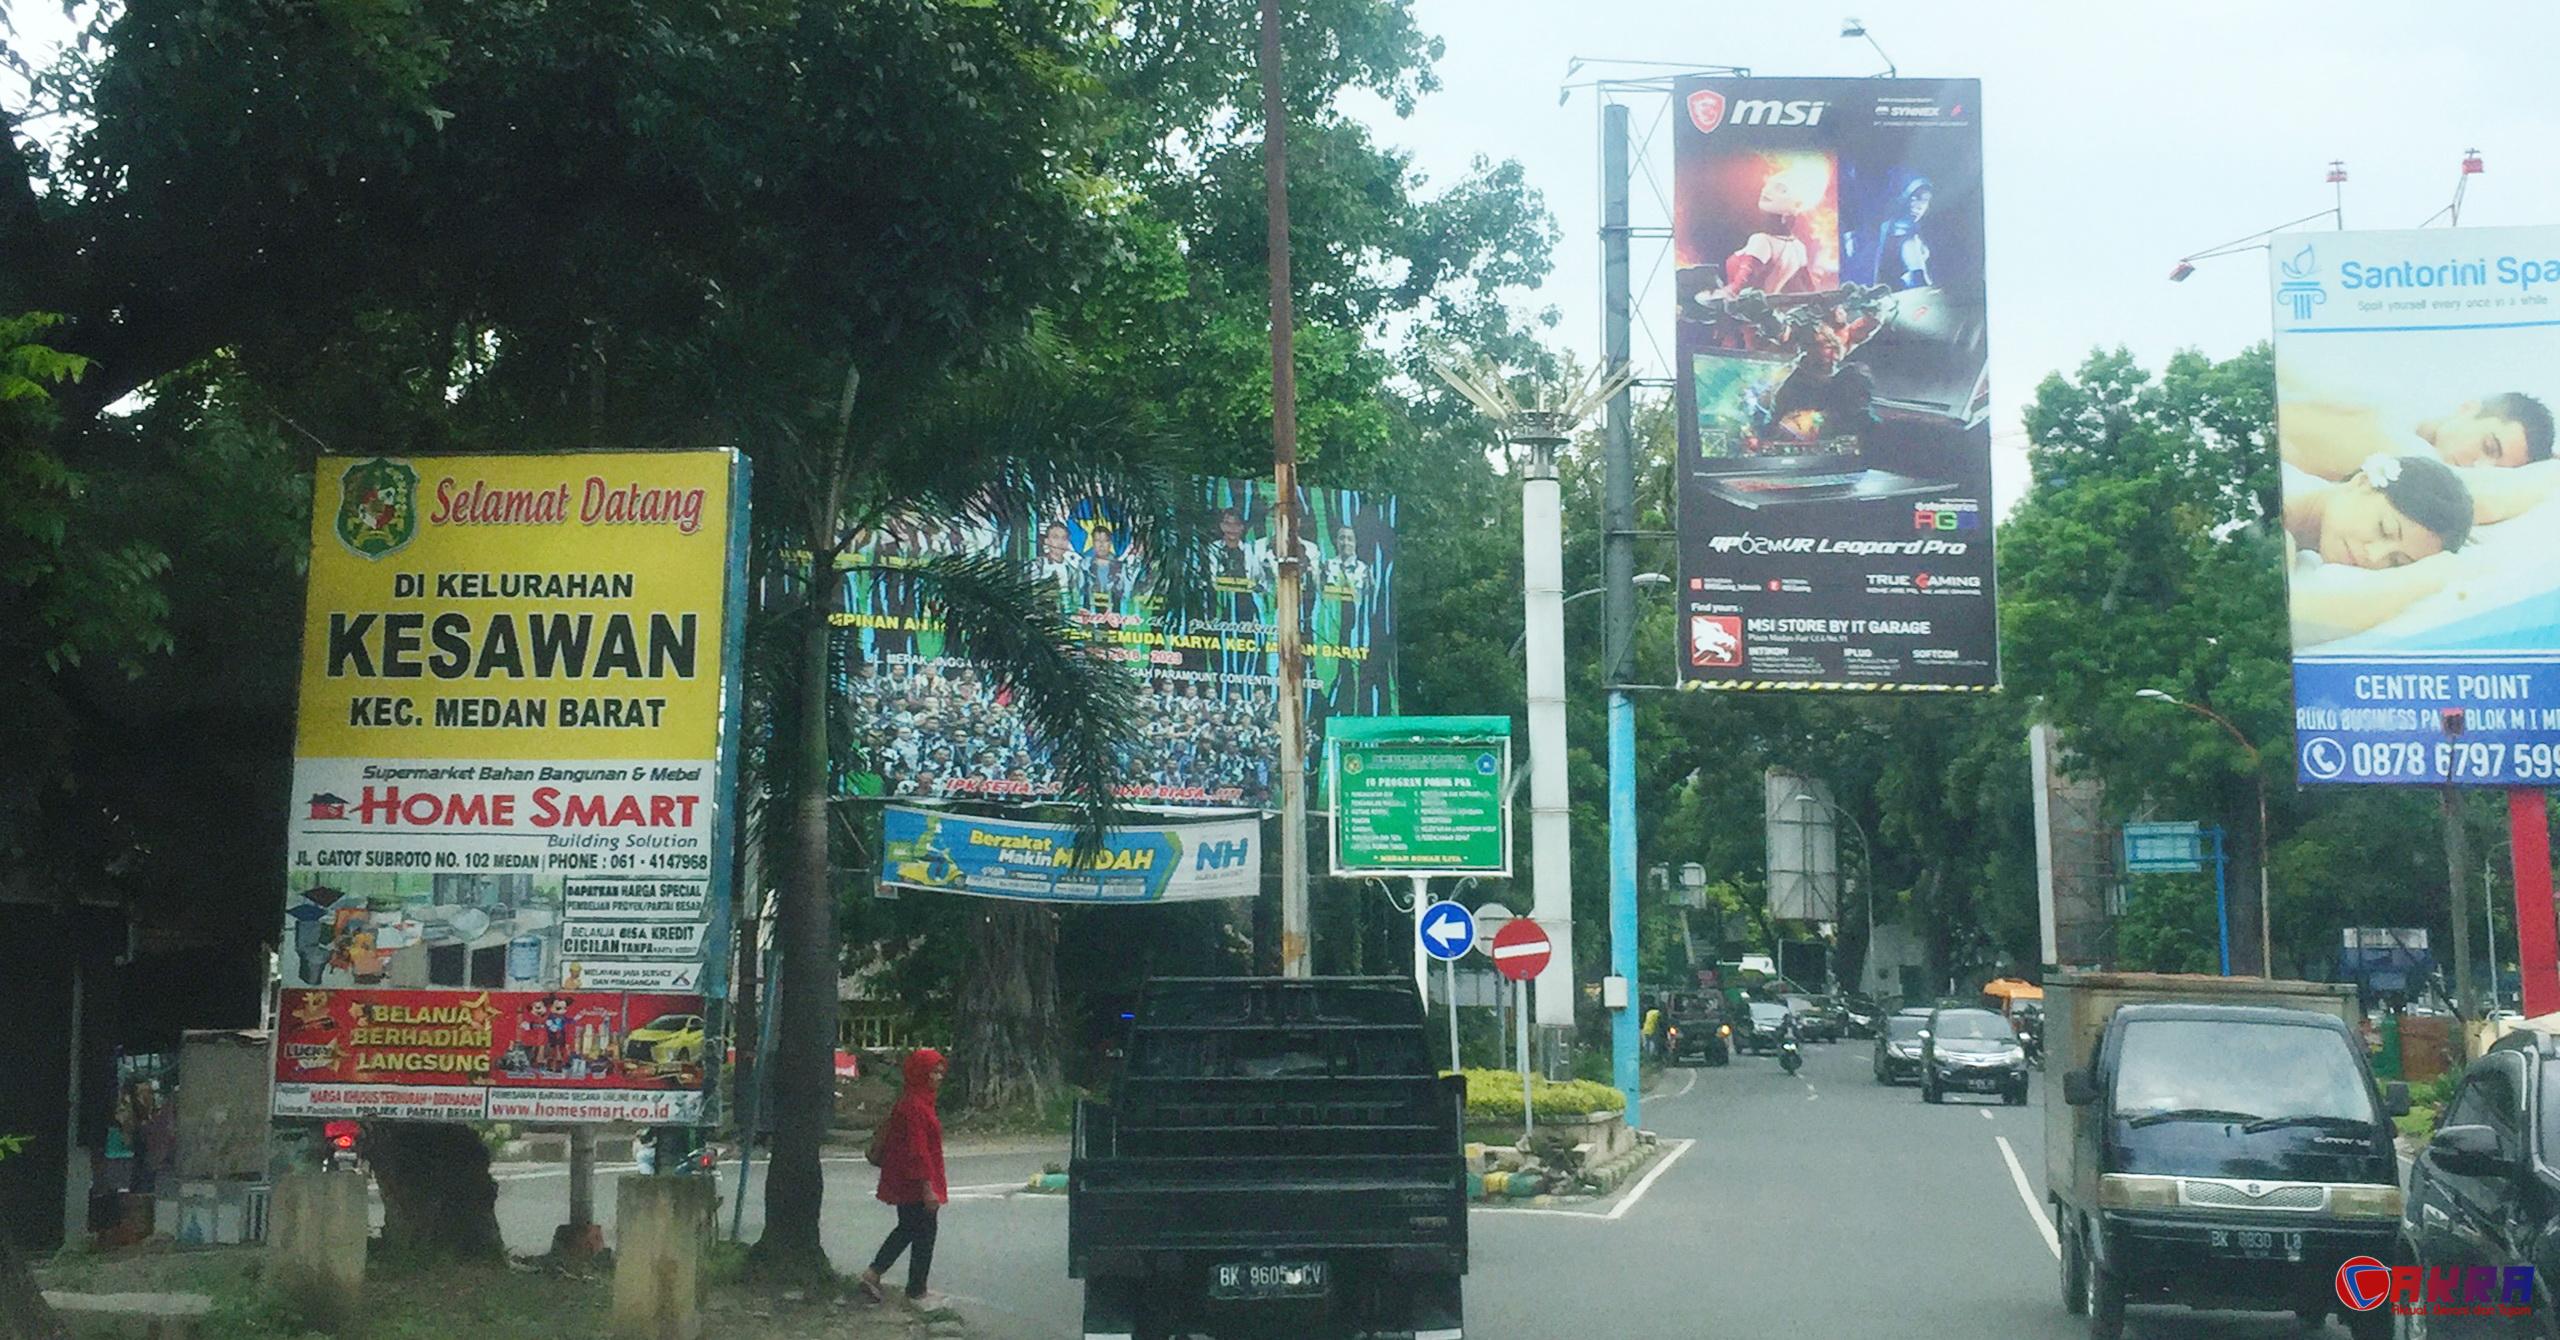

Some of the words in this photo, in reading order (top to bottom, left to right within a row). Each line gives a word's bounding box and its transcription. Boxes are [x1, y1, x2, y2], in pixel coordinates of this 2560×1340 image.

[1729, 99, 1825, 126] msi
[2341, 259, 2487, 289] Santorini
[2497, 256, 2560, 291] Spa
[430, 476, 569, 526] Selamat
[579, 476, 706, 535] Datang
[1816, 538, 1923, 556] Leopard
[1922, 539, 1968, 555] Pro
[394, 573, 425, 598] DI
[436, 573, 633, 598] KELURAHAN
[1866, 575, 1911, 585] TRUE
[1915, 573, 1981, 587] GAMING
[1747, 618, 1776, 632] MSI
[1778, 618, 1827, 633] STORE
[1829, 619, 1849, 633] BY
[1851, 620, 1865, 633] IT
[1868, 620, 1931, 635] GARAGE
[327, 612, 697, 679] KESAWAN
[1170, 633, 1221, 650] KARYA
[1323, 646, 1369, 661] BARAT
[1154, 669, 1218, 683] PARAMOUNT
[2355, 674, 2451, 700] CENTRE
[2457, 674, 2532, 699] POINT
[350, 698, 423, 728] KEC.
[435, 698, 547, 729] MEDAN
[559, 699, 667, 729] BARAT
[2296, 708, 2337, 730] RUKO
[2342, 708, 2416, 731] BUSINESS
[2466, 708, 2506, 731] BLOK
[2510, 708, 2525, 730] M
[2352, 742, 2425, 777] 0878
[2435, 743, 2506, 778] 6797
[362, 766, 477, 783] Supermarket
[479, 766, 534, 781] Bahan
[538, 767, 627, 783] Bangunan
[632, 767, 645, 781] &
[360, 786, 516, 827] HOME
[529, 787, 700, 828] SMART
[547, 833, 620, 851] Building
[626, 833, 698, 849] Solution
[969, 829, 1052, 851] Berzakat
[317, 850, 362, 867] GATOT
[365, 850, 431, 868] SUBROTO
[435, 852, 460, 868] NO.
[465, 852, 490, 868] 102
[493, 854, 539, 869] MEDAN
[549, 853, 598, 869] PHONE
[610, 854, 635, 869] 061
[649, 854, 708, 870] 4147968
[998, 848, 1051, 867] Makin
[1196, 837, 1249, 871] NH
[567, 885, 619, 897] DAPATKAN
[621, 884, 656, 897] HARGA
[660, 884, 702, 897] SPECIAL
[571, 927, 615, 938] BELANJA
[619, 927, 647, 940] BISA
[652, 926, 695, 940] KREDIT
[564, 939, 620, 953] CICILAN
[373, 1005, 473, 1024] BELANJA
[351, 1028, 492, 1048] BERHADIAH
[356, 1053, 490, 1072] LANGSUNG
[310, 1090, 342, 1104] HARGA
[356, 1106, 398, 1116] PROJEK
[407, 1107, 444, 1117] PARTAI
[447, 1108, 481, 1118] BESAR
[2212, 1230, 2229, 1247] BK
[1220, 1266, 1240, 1287] BK
[1302, 1263, 1321, 1286] CV
